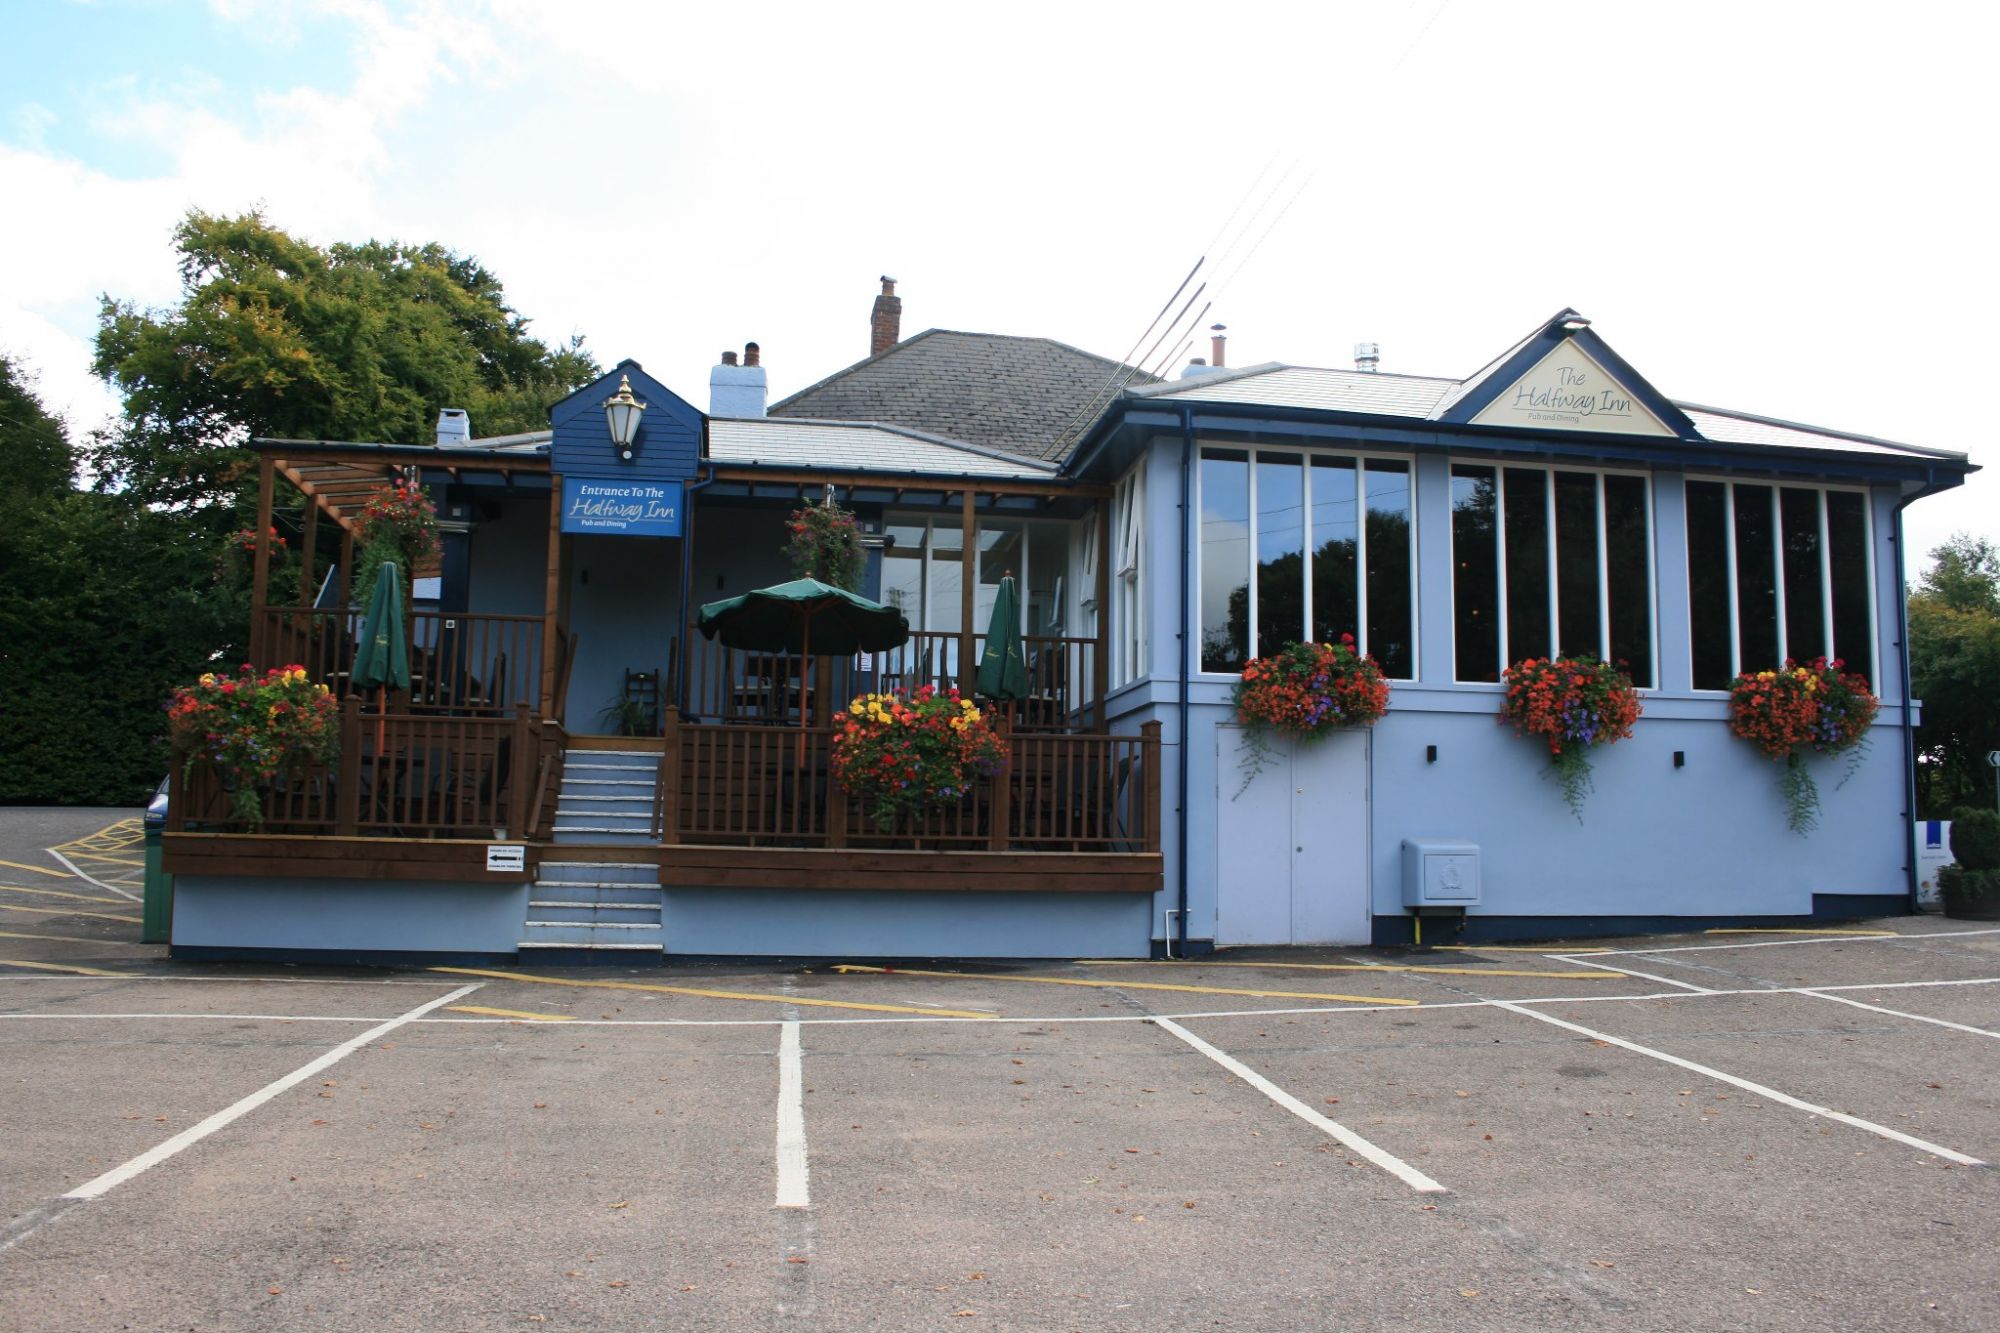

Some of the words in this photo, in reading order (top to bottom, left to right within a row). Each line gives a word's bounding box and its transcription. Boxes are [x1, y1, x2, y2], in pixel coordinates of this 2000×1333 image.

[1557, 366, 1586, 386] The
[1513, 385, 1595, 416] Halfway
[1599, 390, 1632, 412] Inn
[1528, 412, 1541, 420] Pub
[1542, 413, 1555, 421] and
[1556, 414, 1579, 423] Dining
[581, 485, 630, 497] Entrance
[631, 487, 643, 497] To
[645, 487, 664, 498] The
[568, 497, 643, 522] Halfway
[644, 500, 675, 518] Inn
[606, 521, 627, 529] Dining
